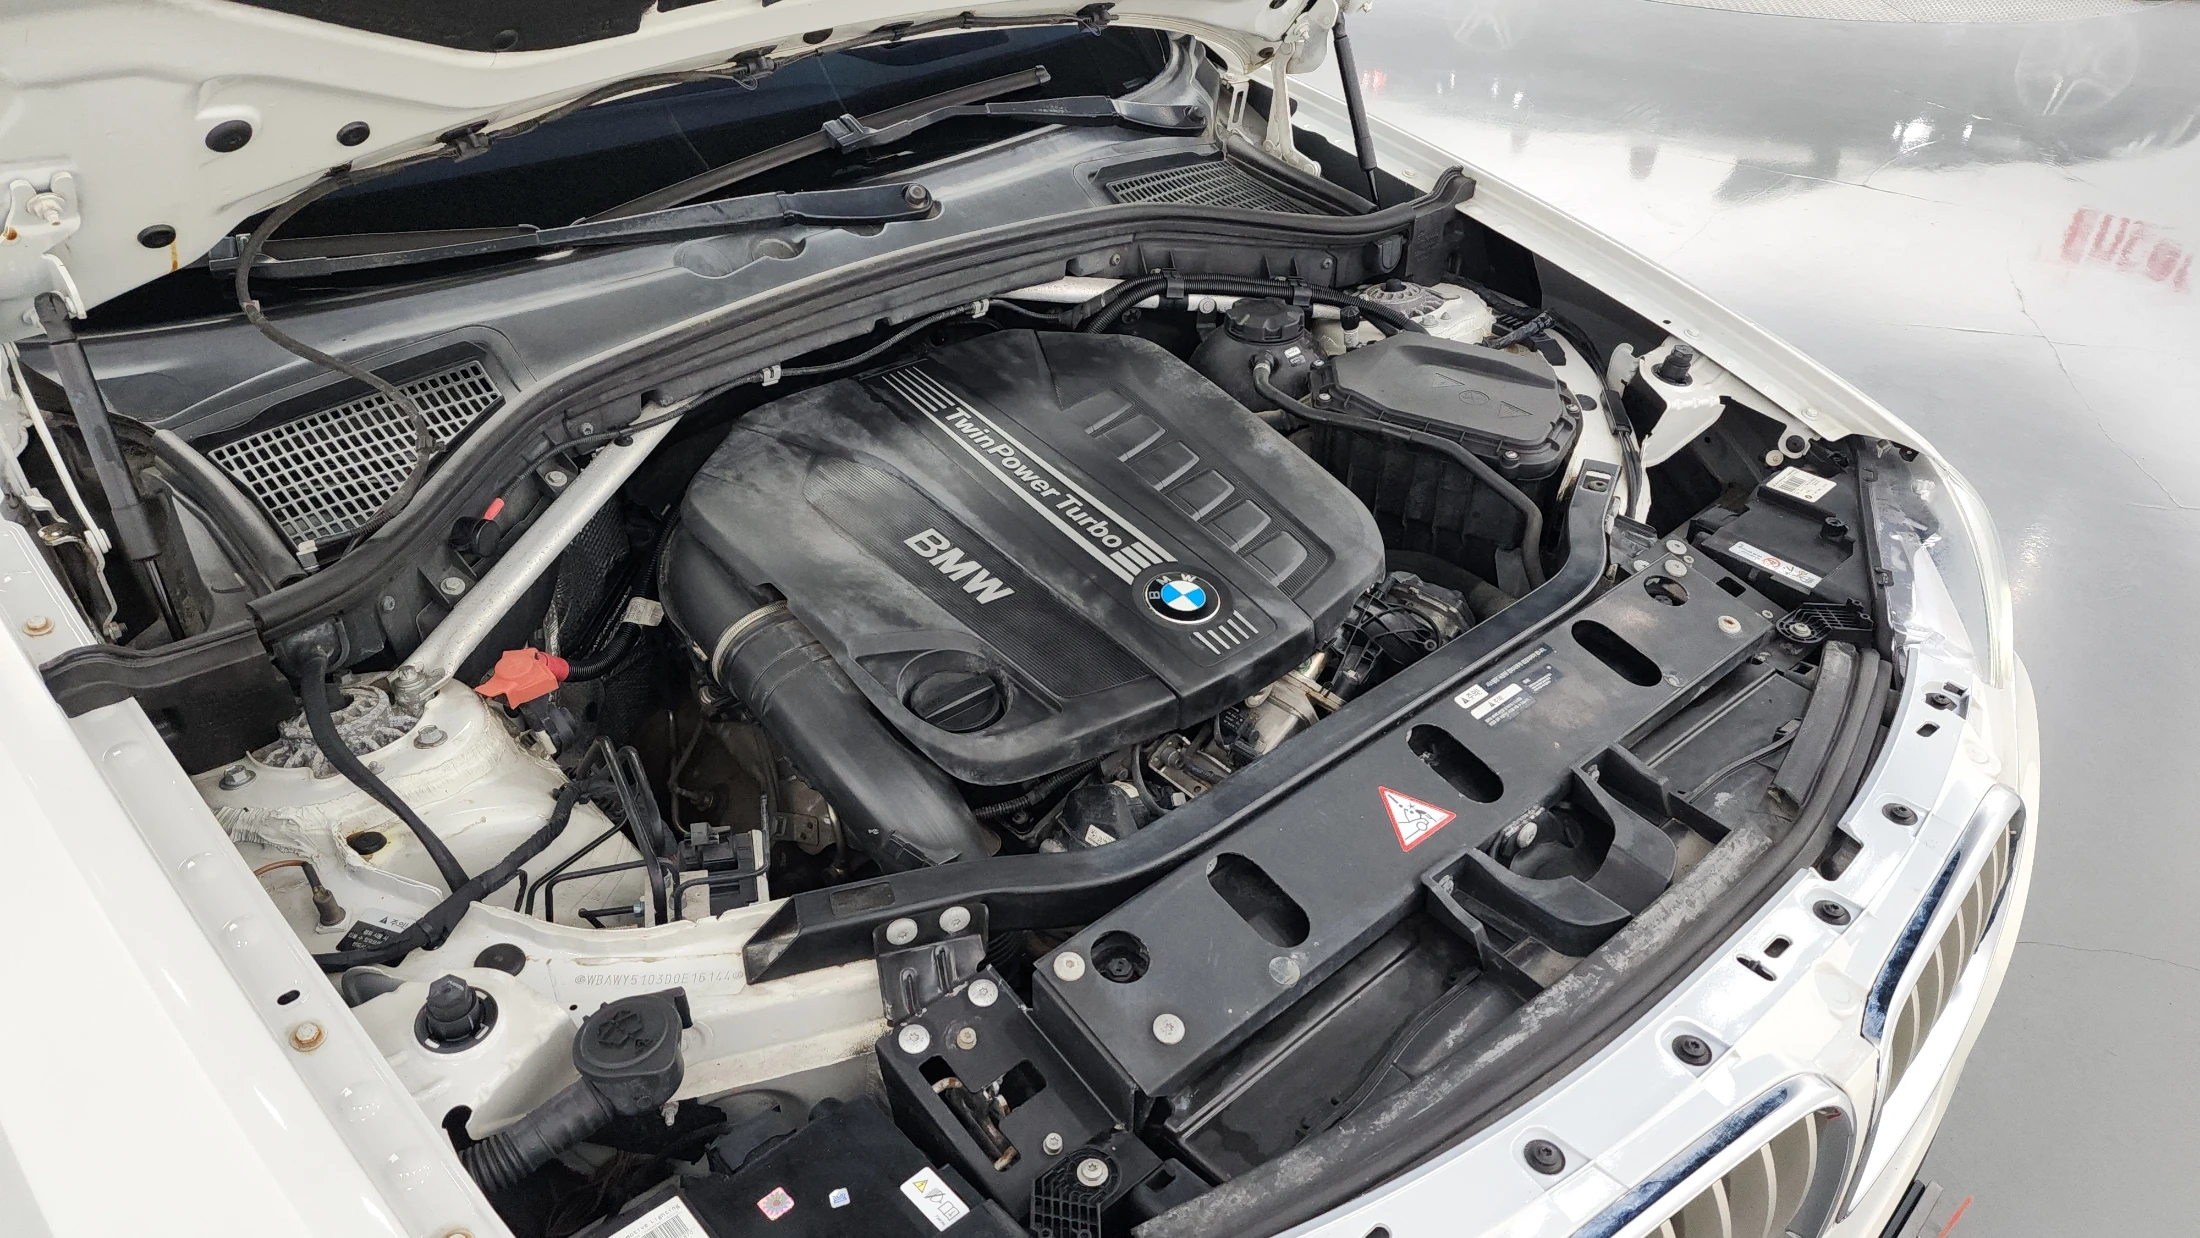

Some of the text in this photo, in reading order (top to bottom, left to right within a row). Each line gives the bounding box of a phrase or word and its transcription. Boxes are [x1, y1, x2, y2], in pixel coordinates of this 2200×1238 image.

[945, 407, 1122, 548] TwinPower Turbo
[903, 528, 1015, 604] BMW
[1149, 573, 1197, 600] BMW
